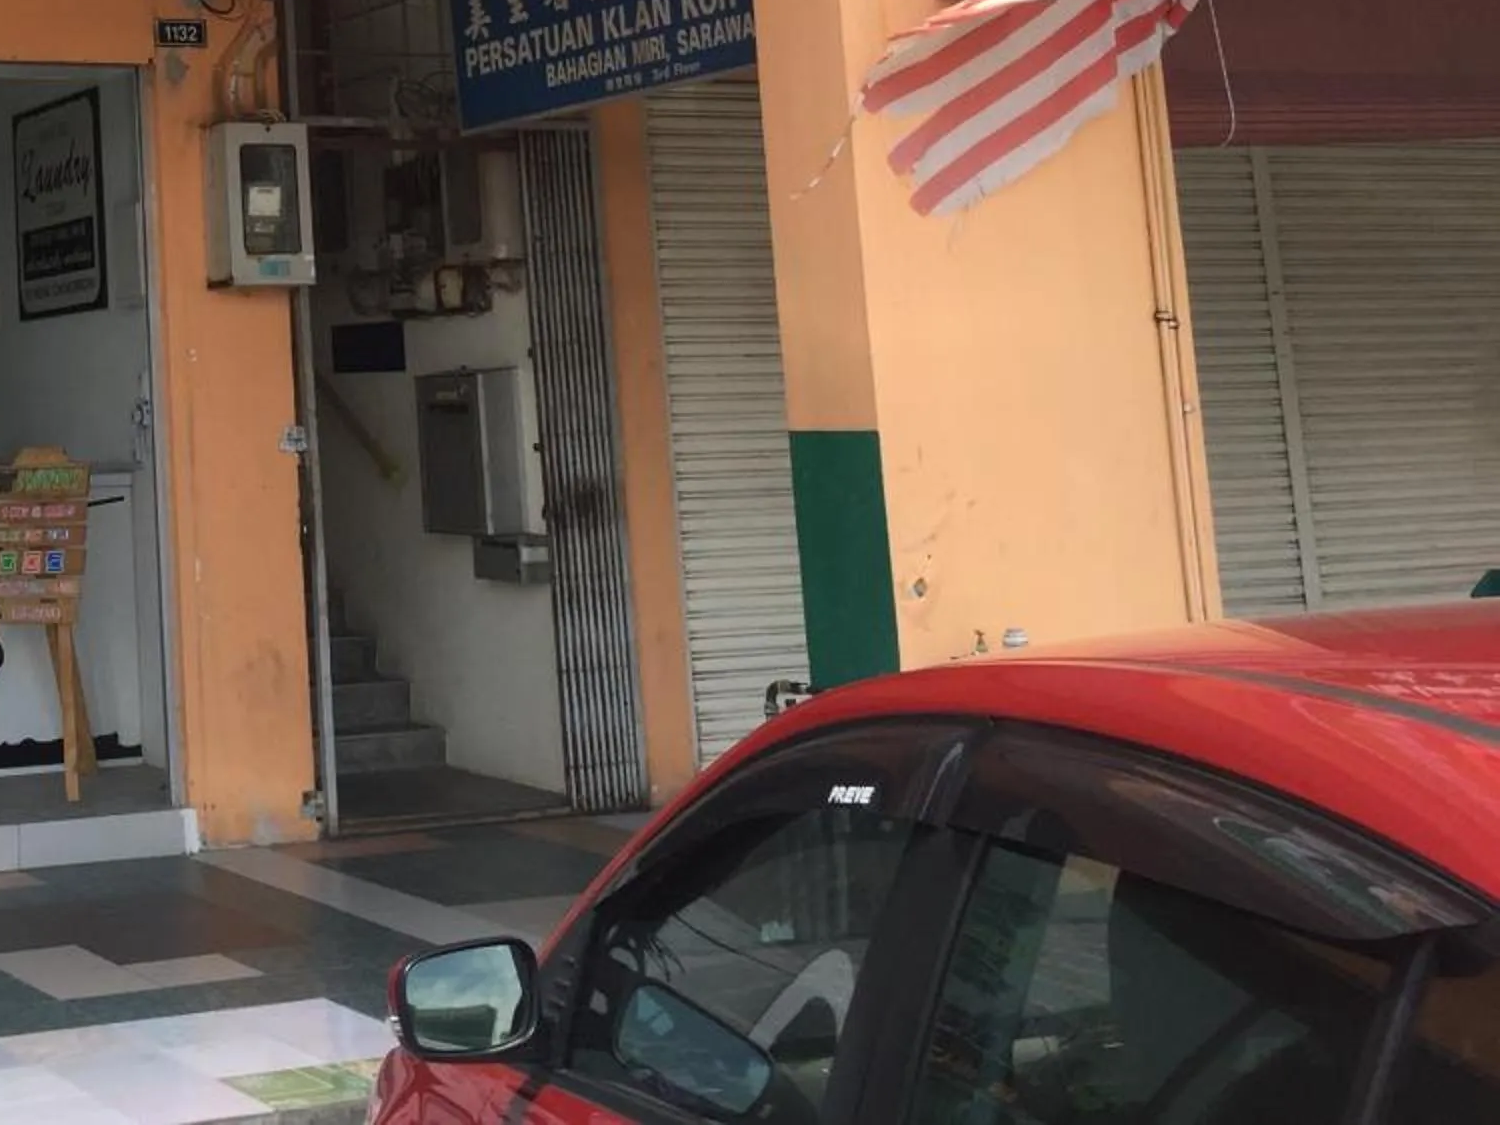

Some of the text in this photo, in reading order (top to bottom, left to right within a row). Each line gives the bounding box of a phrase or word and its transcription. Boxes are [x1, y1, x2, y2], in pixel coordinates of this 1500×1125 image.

[164, 25, 197, 42] 1132
[465, 14, 594, 78] PERSATUAN
[545, 45, 627, 88] BAHAGIAN
[676, 11, 757, 56] SARAWA
